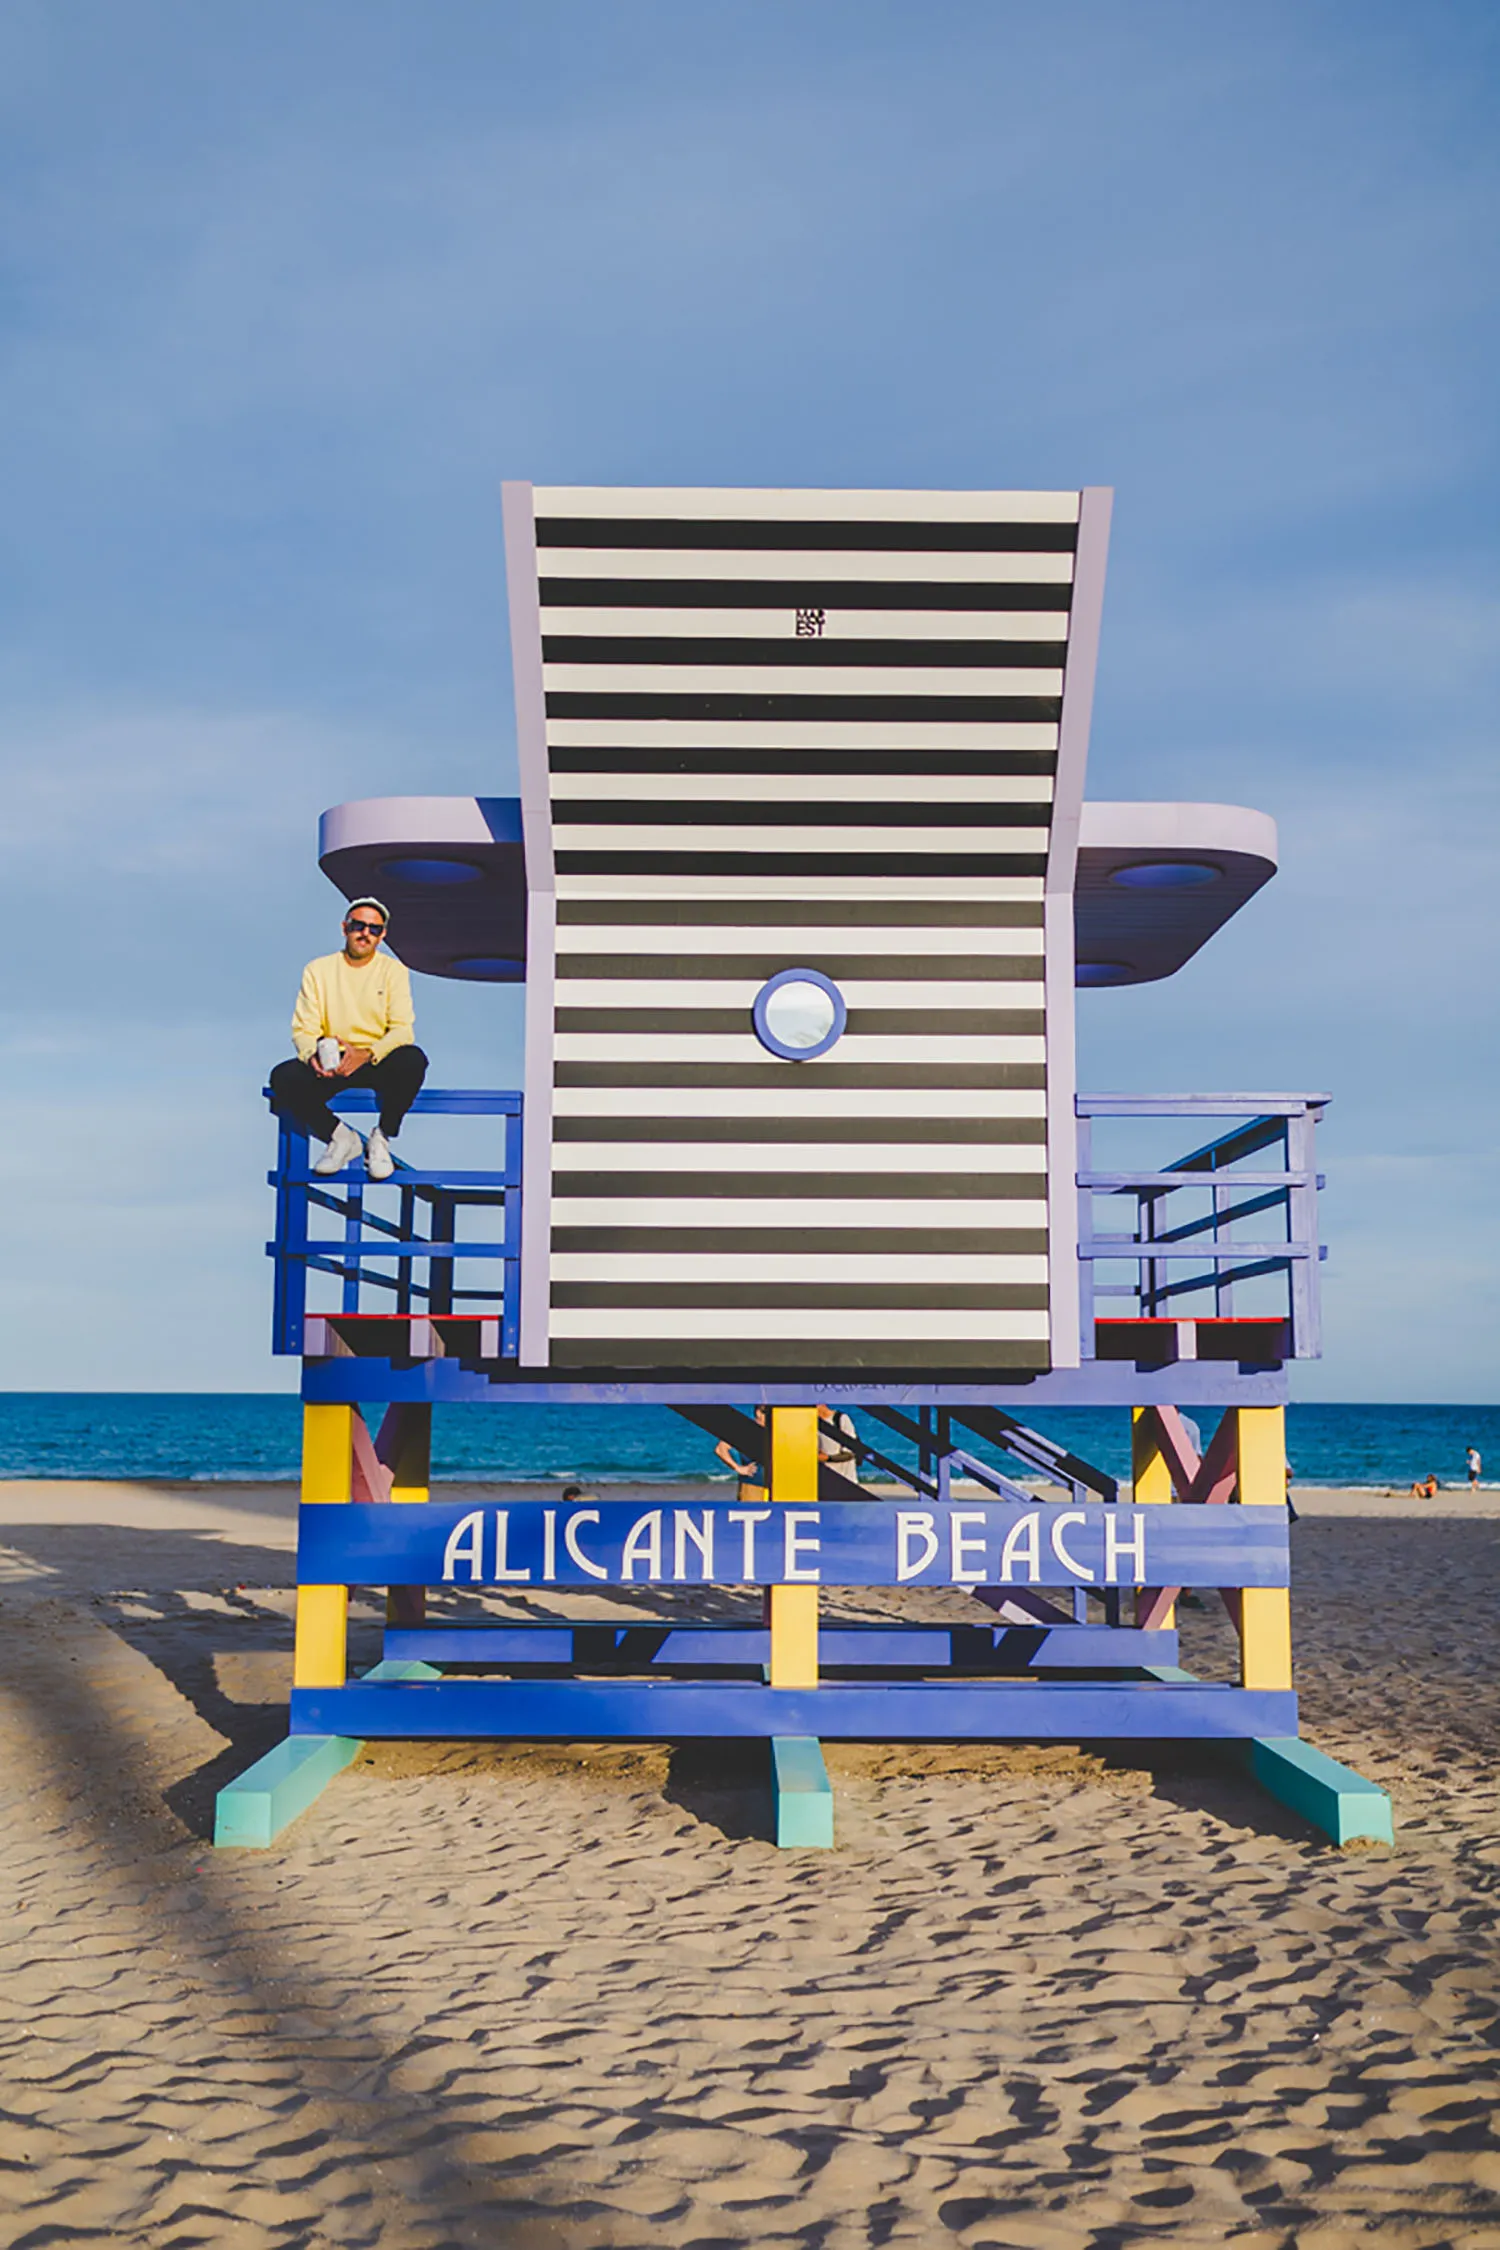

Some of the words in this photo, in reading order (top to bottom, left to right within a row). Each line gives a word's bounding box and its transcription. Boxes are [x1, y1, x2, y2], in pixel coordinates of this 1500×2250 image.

[796, 620, 825, 636] EST
[442, 1509, 822, 1581] ALICANTE
[896, 1512, 1147, 1583] BEACH
